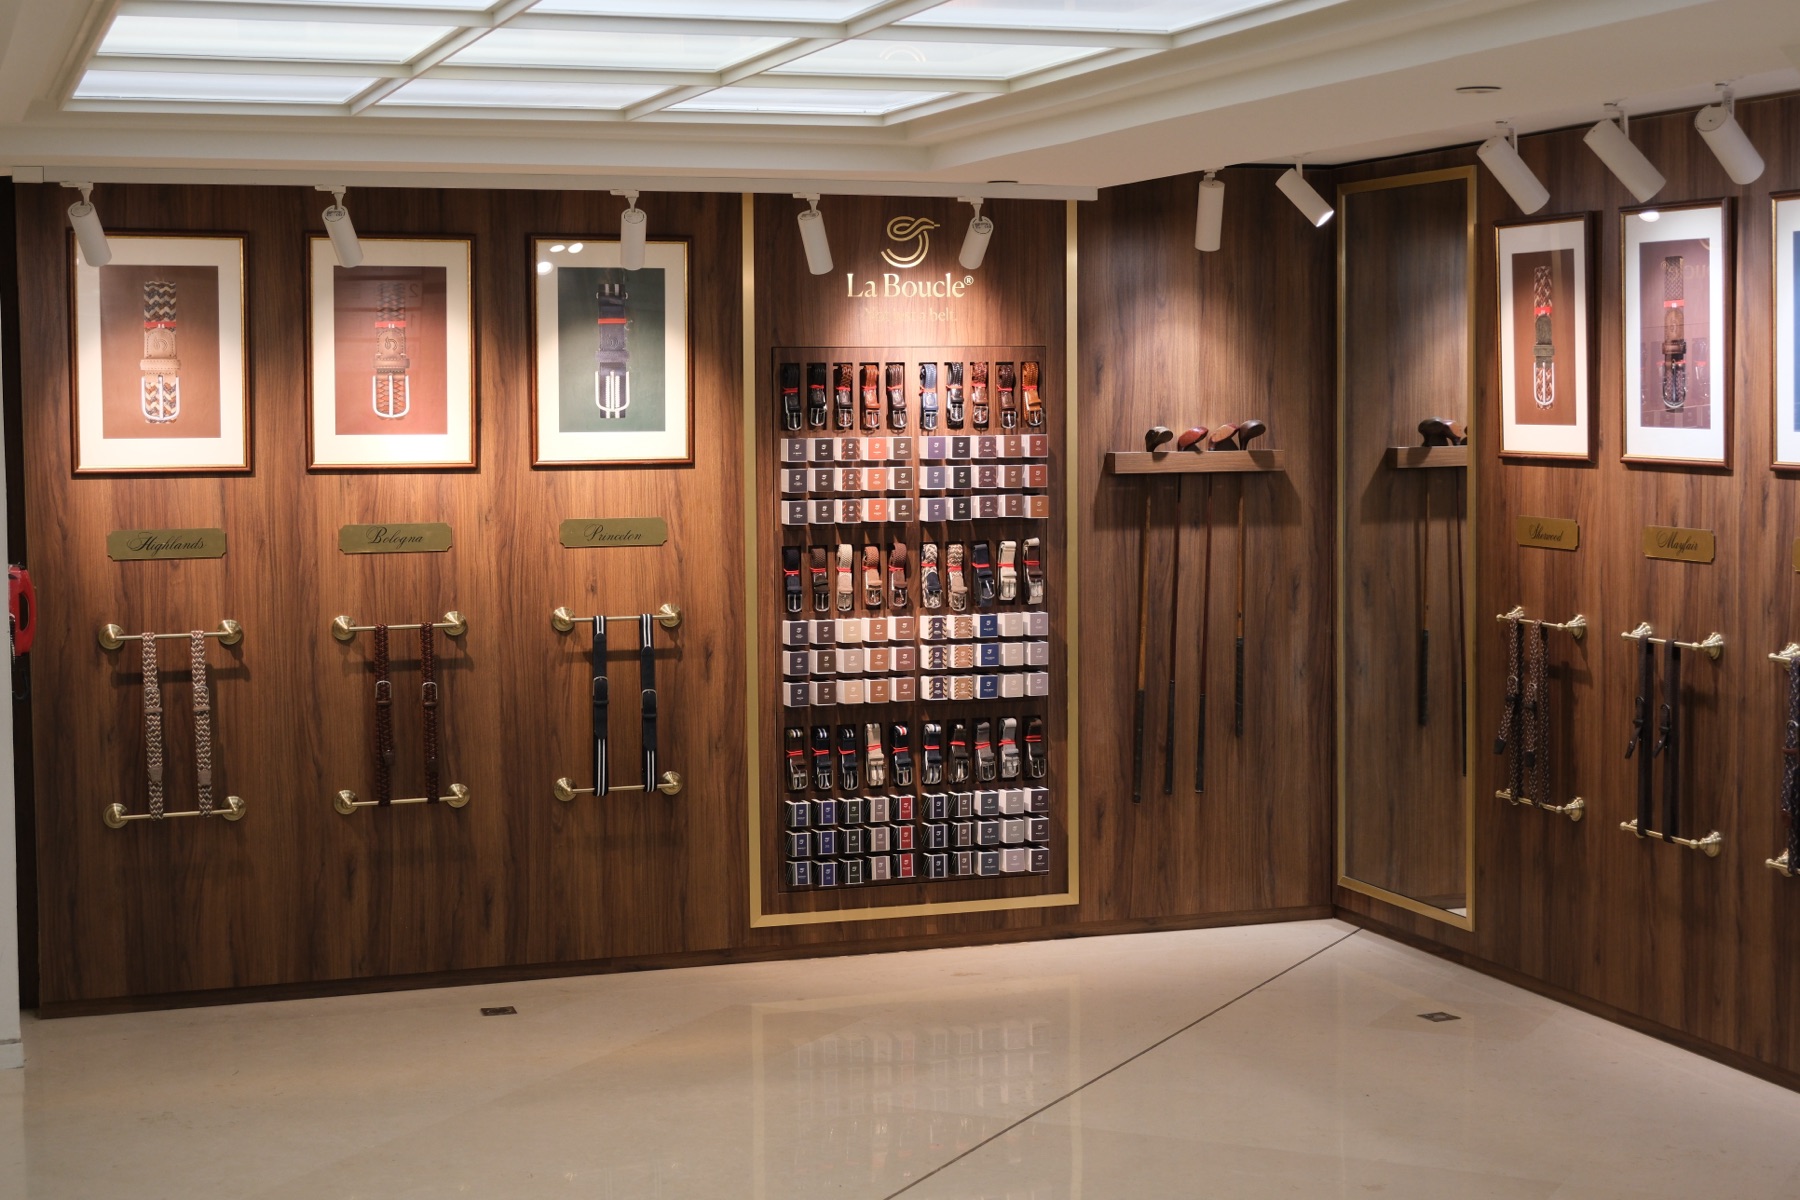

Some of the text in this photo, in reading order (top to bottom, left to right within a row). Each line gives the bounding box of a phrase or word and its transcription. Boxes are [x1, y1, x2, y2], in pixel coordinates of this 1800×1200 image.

[847, 273, 877, 298] La
[127, 531, 206, 557] Highlands
[366, 525, 424, 549] Bologna
[583, 523, 643, 542] Princeton
[1528, 522, 1564, 542] Sherwood
[1656, 529, 1699, 556] Mayfair
